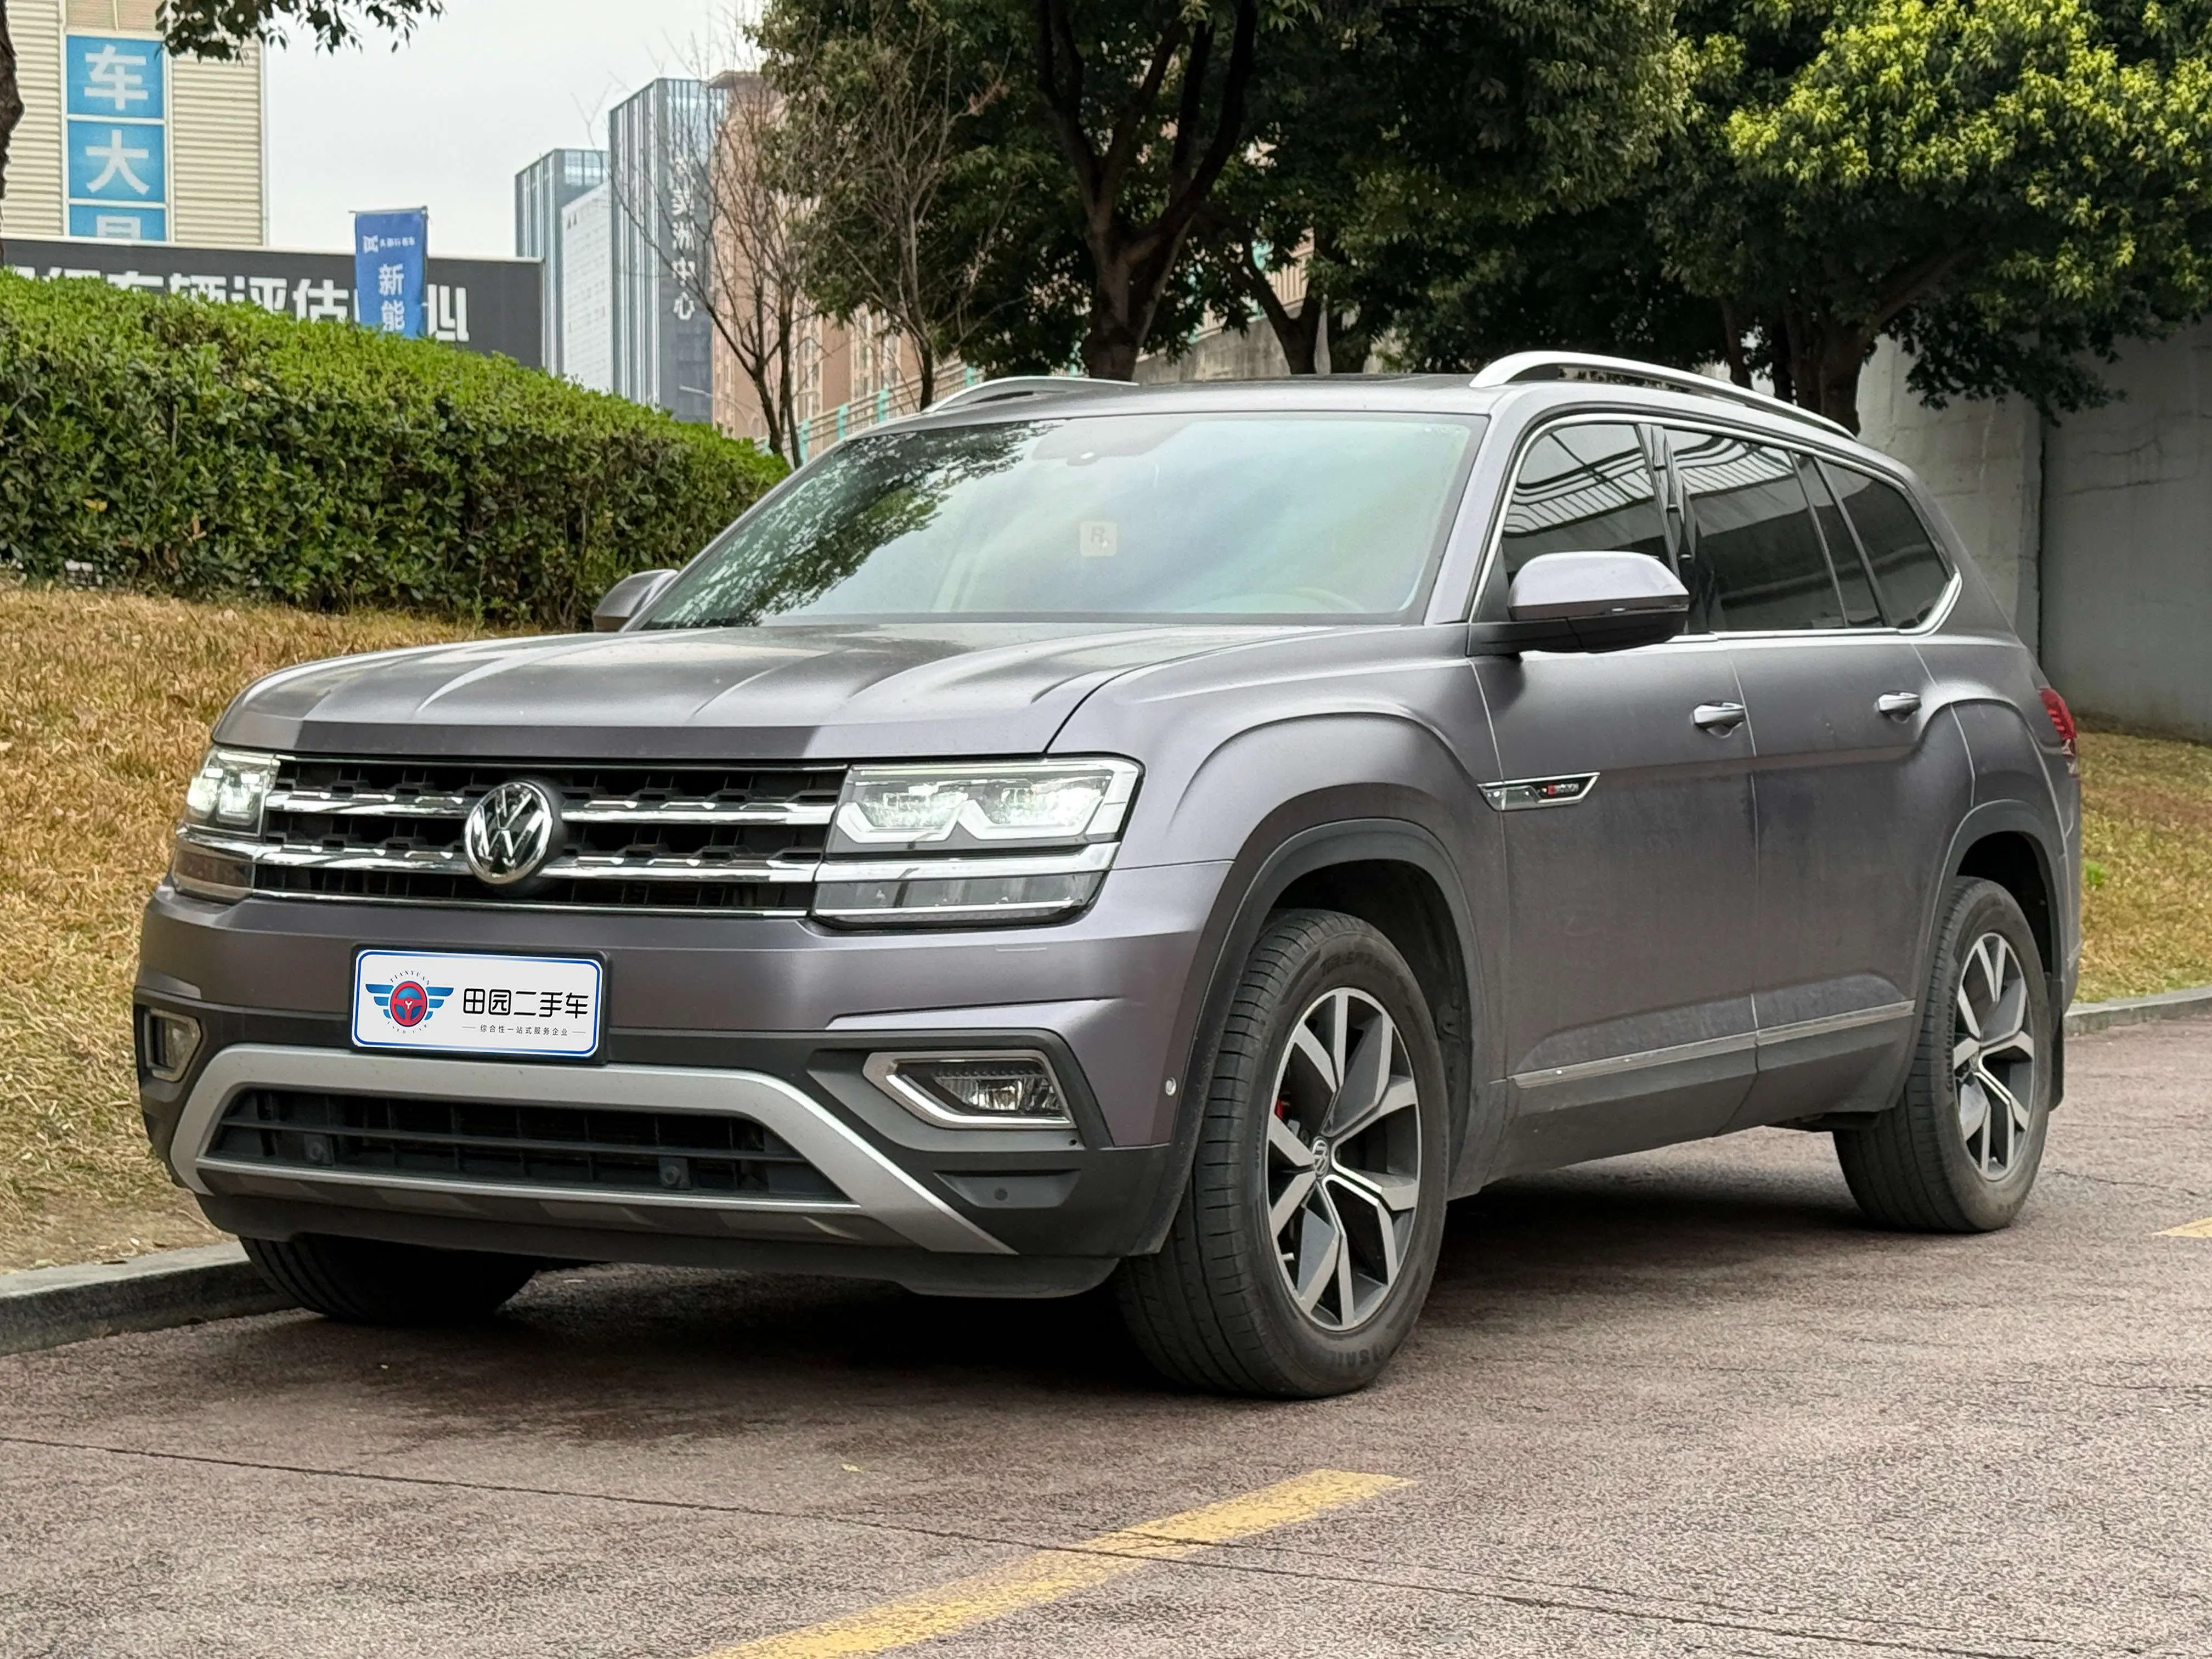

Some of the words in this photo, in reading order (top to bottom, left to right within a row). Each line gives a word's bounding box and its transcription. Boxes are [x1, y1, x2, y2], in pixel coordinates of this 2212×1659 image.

[463, 988, 589, 1019] 田园二手车
[480, 1024, 568, 1036] 综合性一站式服务企业
